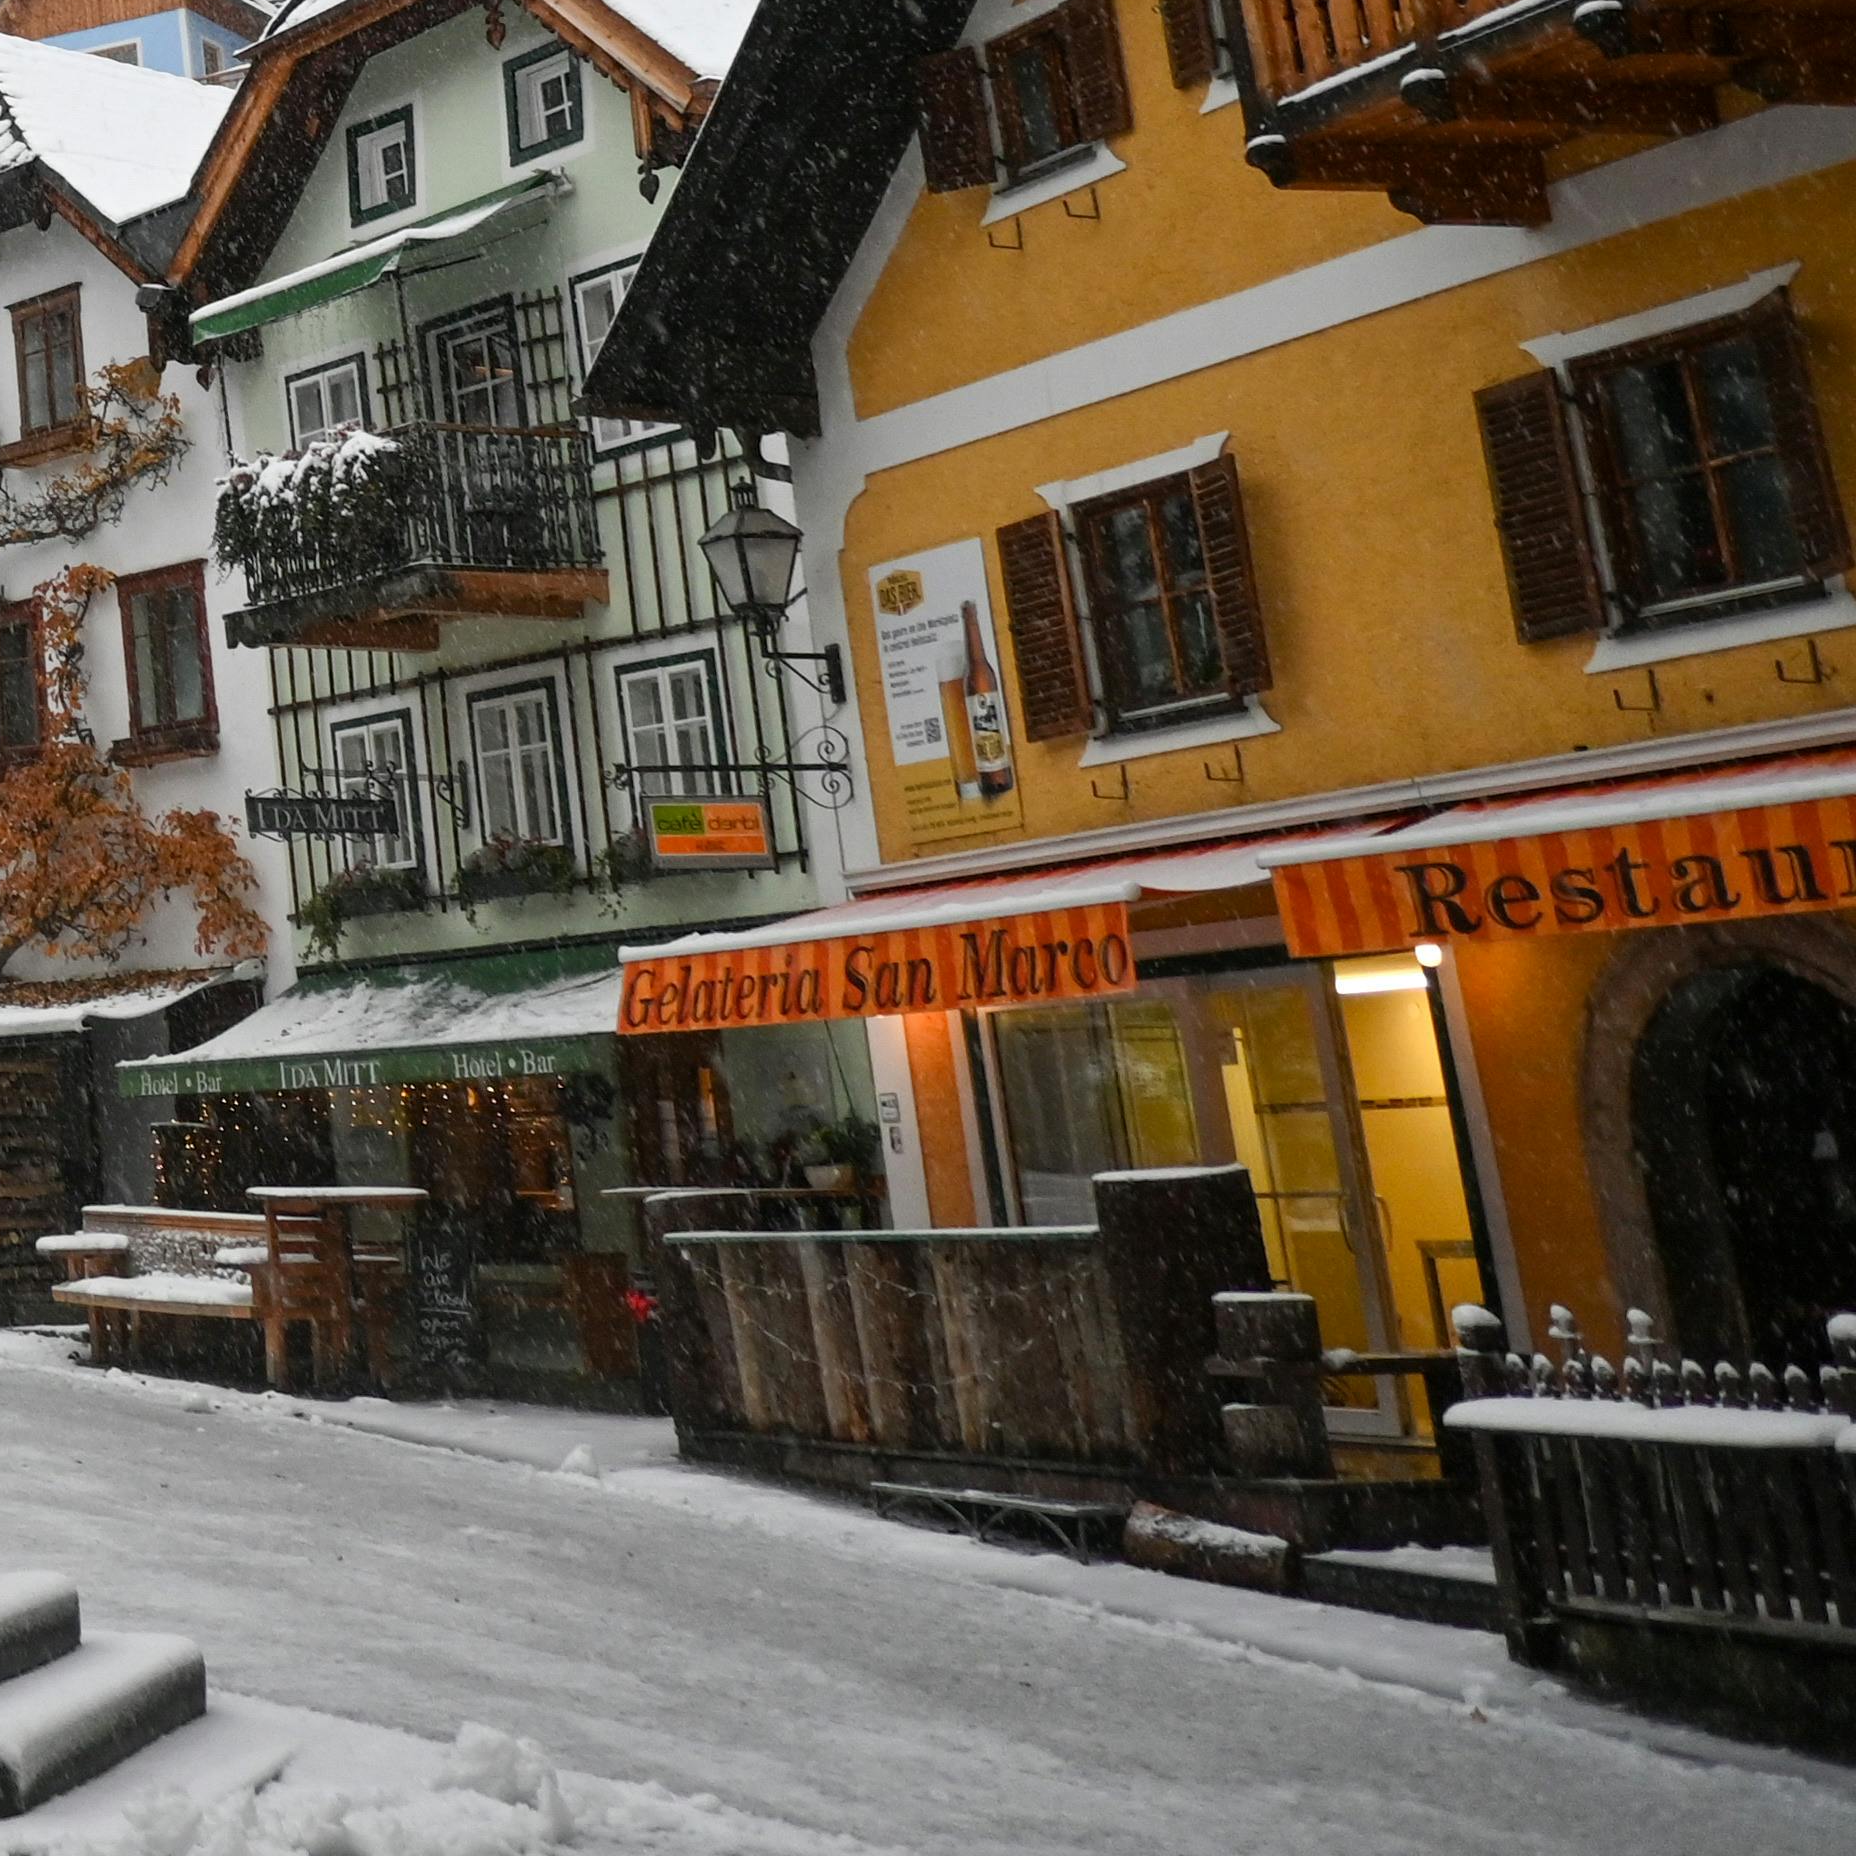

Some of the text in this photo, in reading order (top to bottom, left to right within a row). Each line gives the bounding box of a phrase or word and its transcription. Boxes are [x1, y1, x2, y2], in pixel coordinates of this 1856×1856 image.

[257, 802, 384, 830] IDA MITT
[624, 930, 1128, 1028] Gelateria San Marco
[280, 1057, 380, 1089] IDA MITT
[452, 1051, 556, 1079] Hotel Bar
[140, 1071, 223, 1096] Hotel Bar
